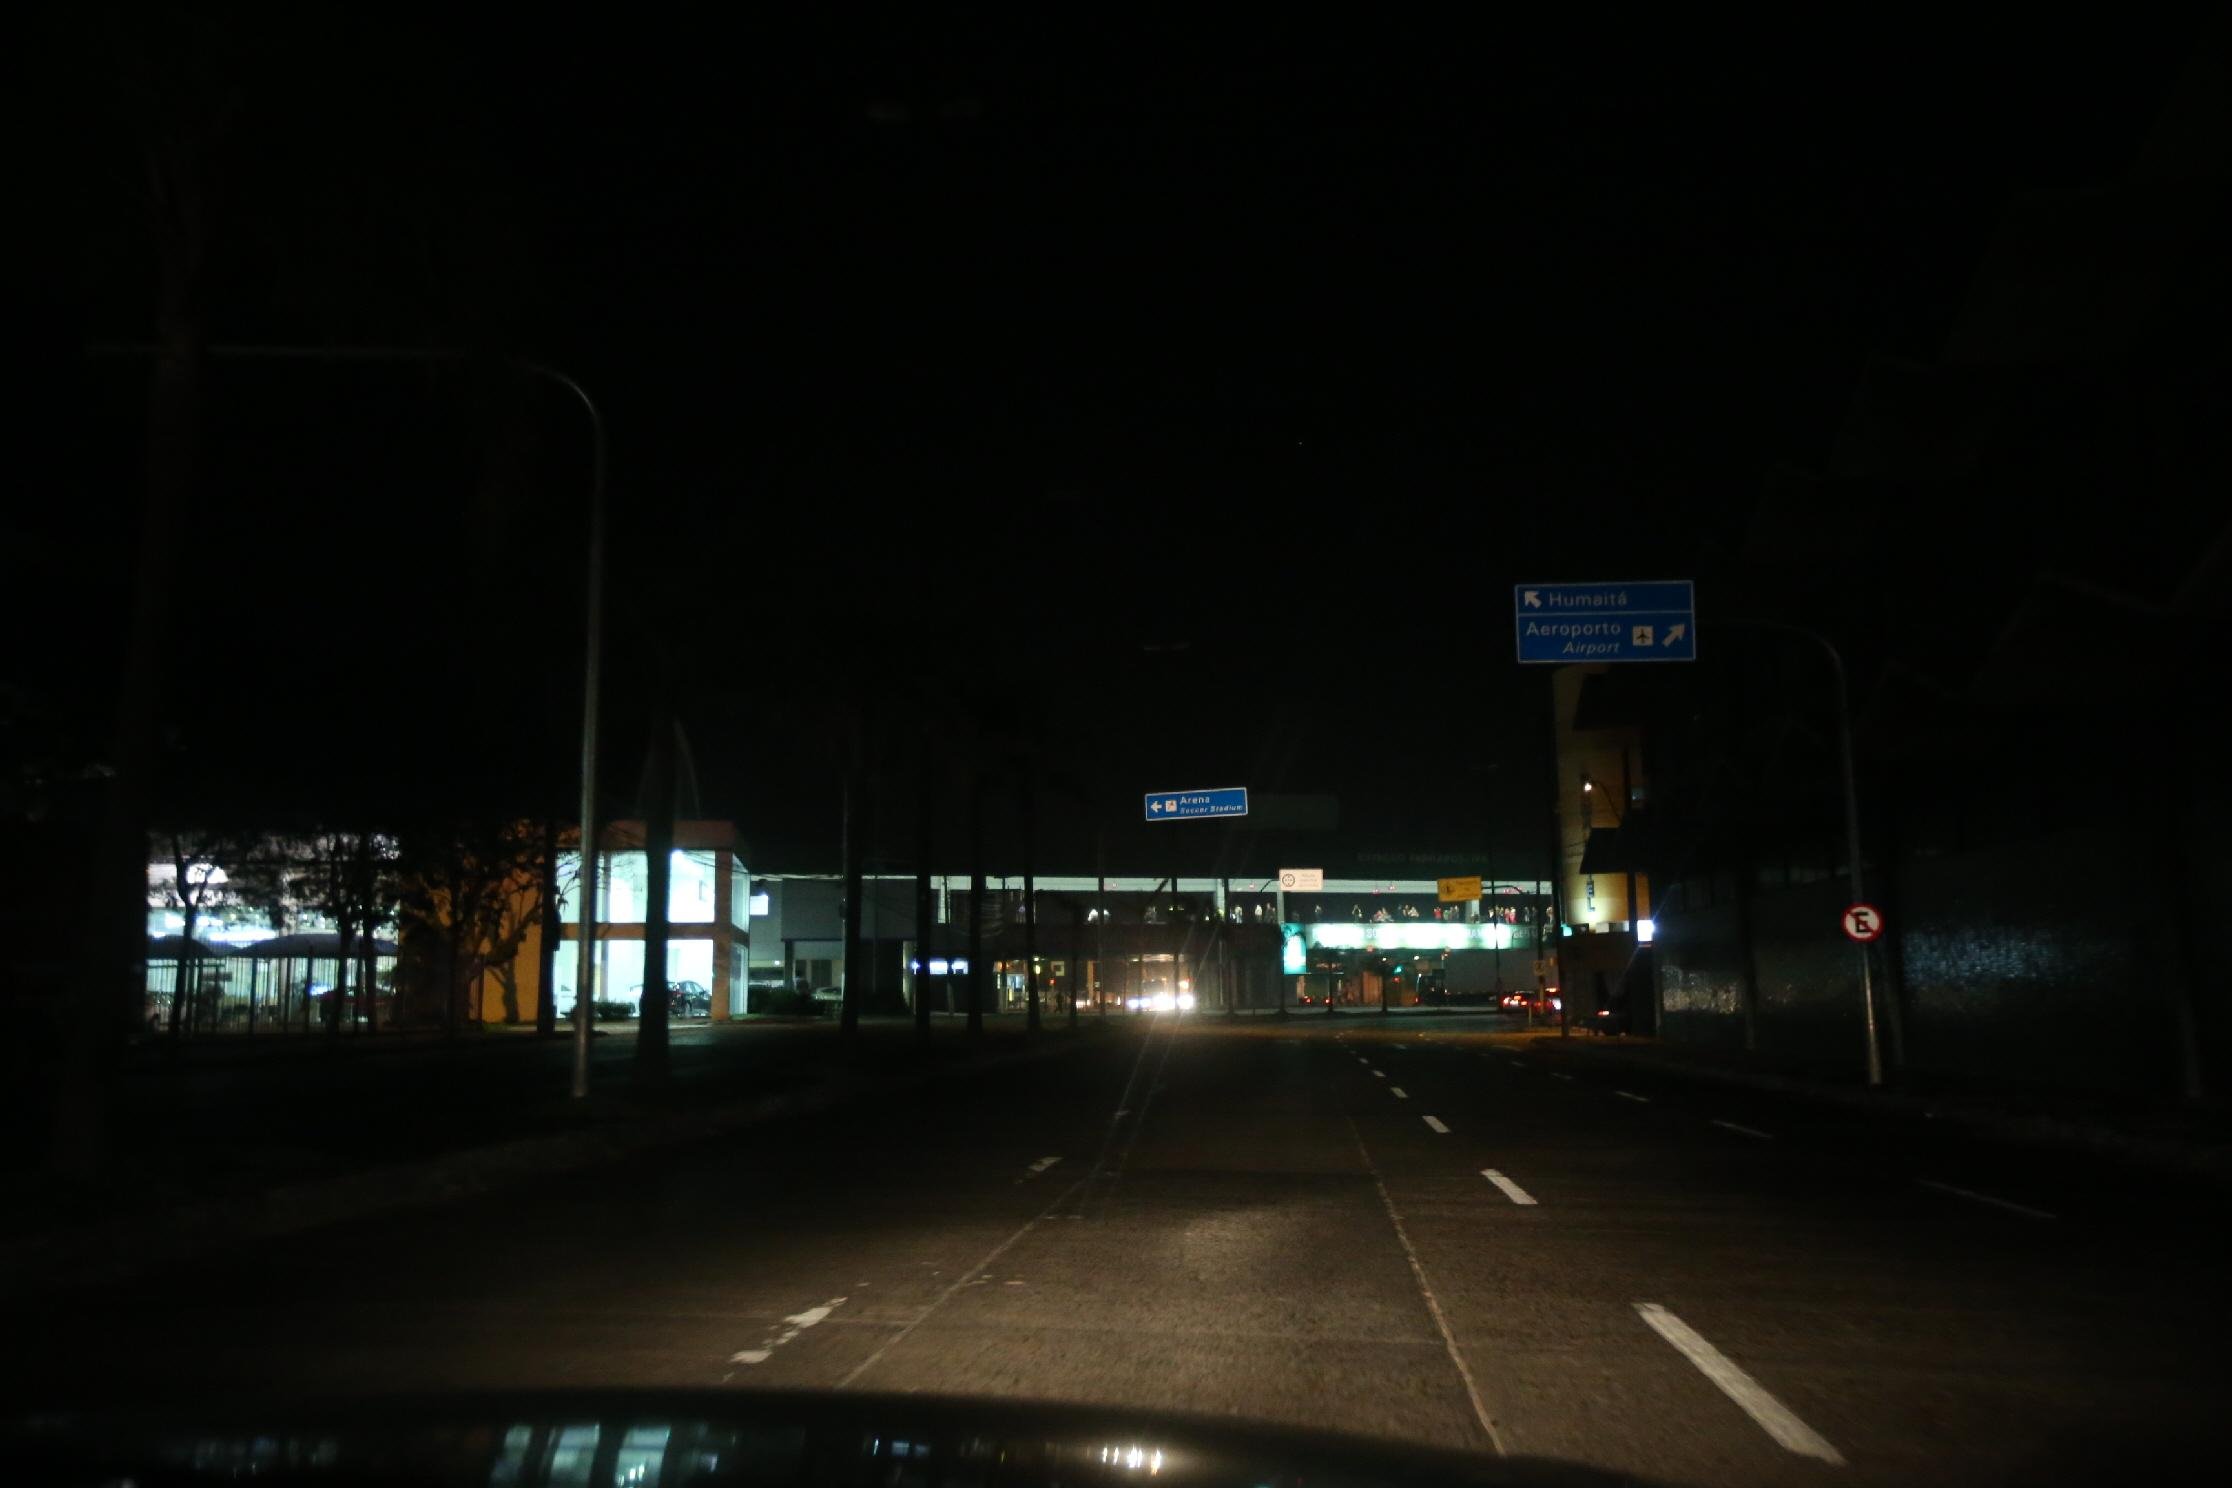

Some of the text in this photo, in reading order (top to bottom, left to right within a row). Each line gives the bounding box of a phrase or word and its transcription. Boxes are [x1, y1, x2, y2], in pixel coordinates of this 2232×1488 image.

[1549, 591, 1628, 607] Humaitá
[1526, 621, 1621, 637] Aeroporto
[1562, 641, 1620, 655] Airport
[1180, 796, 1210, 805] Arena
